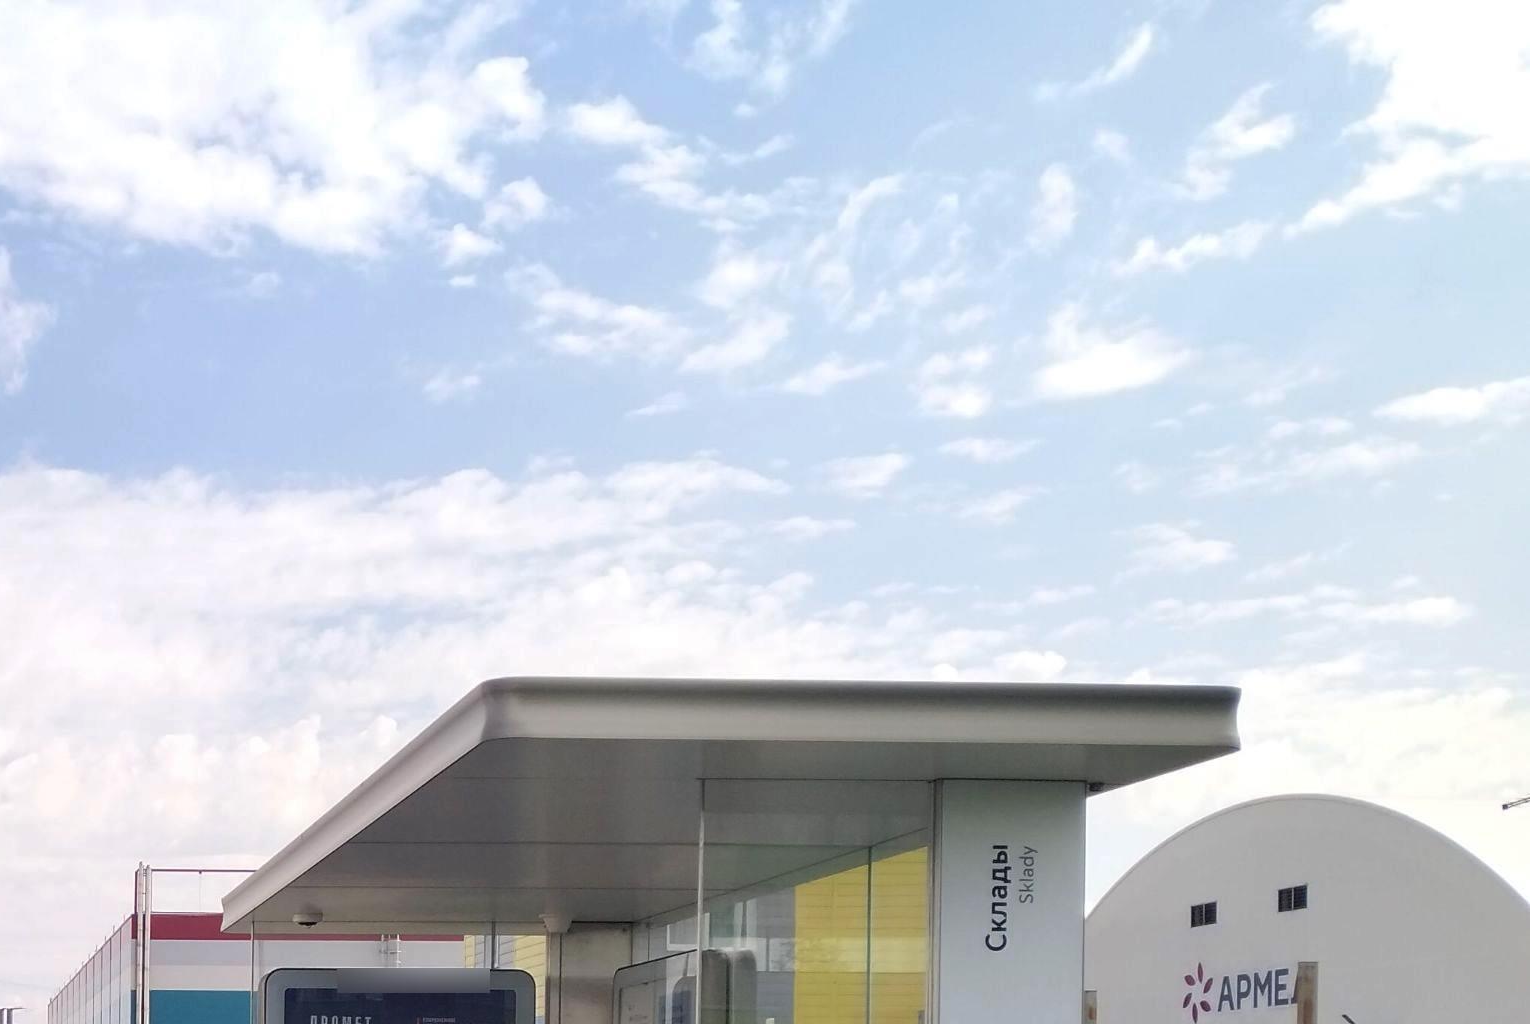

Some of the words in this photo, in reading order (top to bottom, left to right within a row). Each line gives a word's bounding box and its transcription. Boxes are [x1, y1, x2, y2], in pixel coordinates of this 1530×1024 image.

[985, 845, 1012, 952] Склады
[1019, 846, 1038, 904] Sklady
[1218, 968, 1299, 1012] АРМЕ
